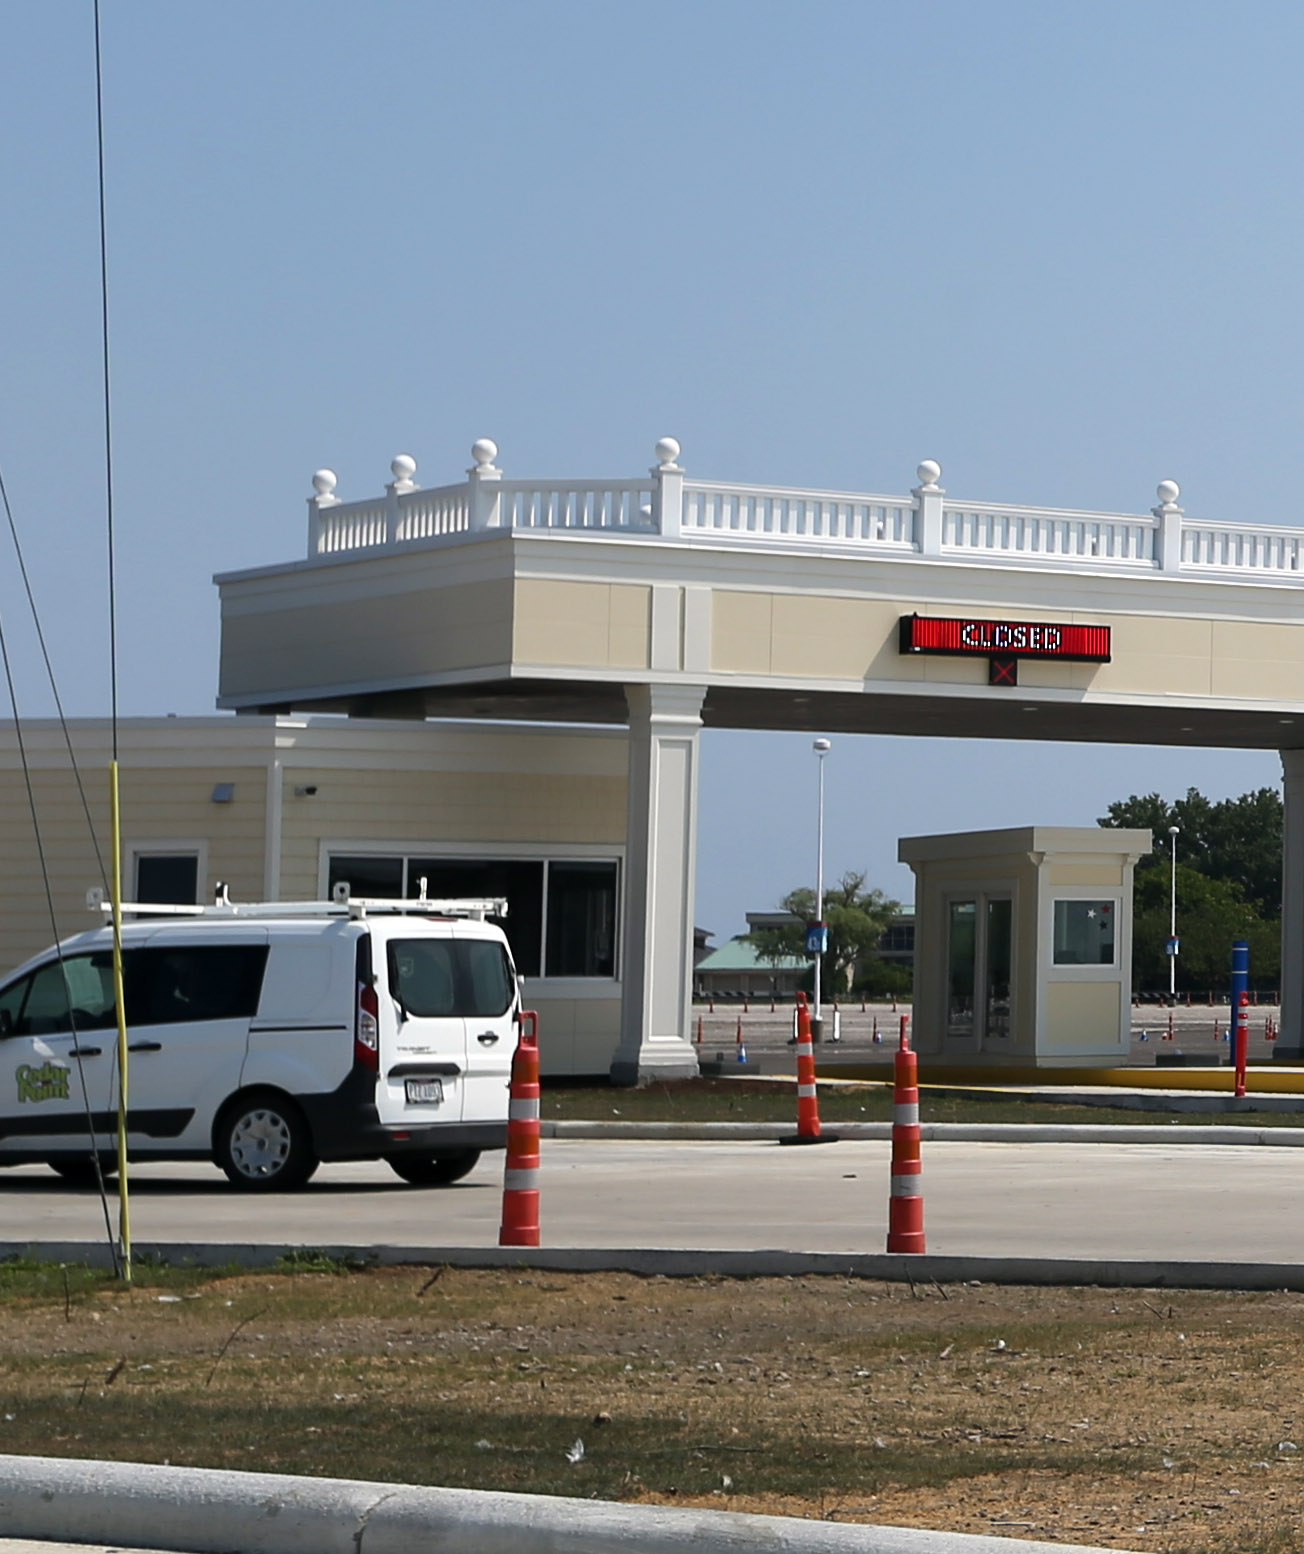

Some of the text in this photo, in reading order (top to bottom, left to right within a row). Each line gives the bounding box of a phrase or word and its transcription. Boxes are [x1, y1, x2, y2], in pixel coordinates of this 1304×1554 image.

[963, 624, 1061, 650] CLOSED
[16, 1061, 70, 1083] Cedar
[18, 1079, 69, 1103] Point
